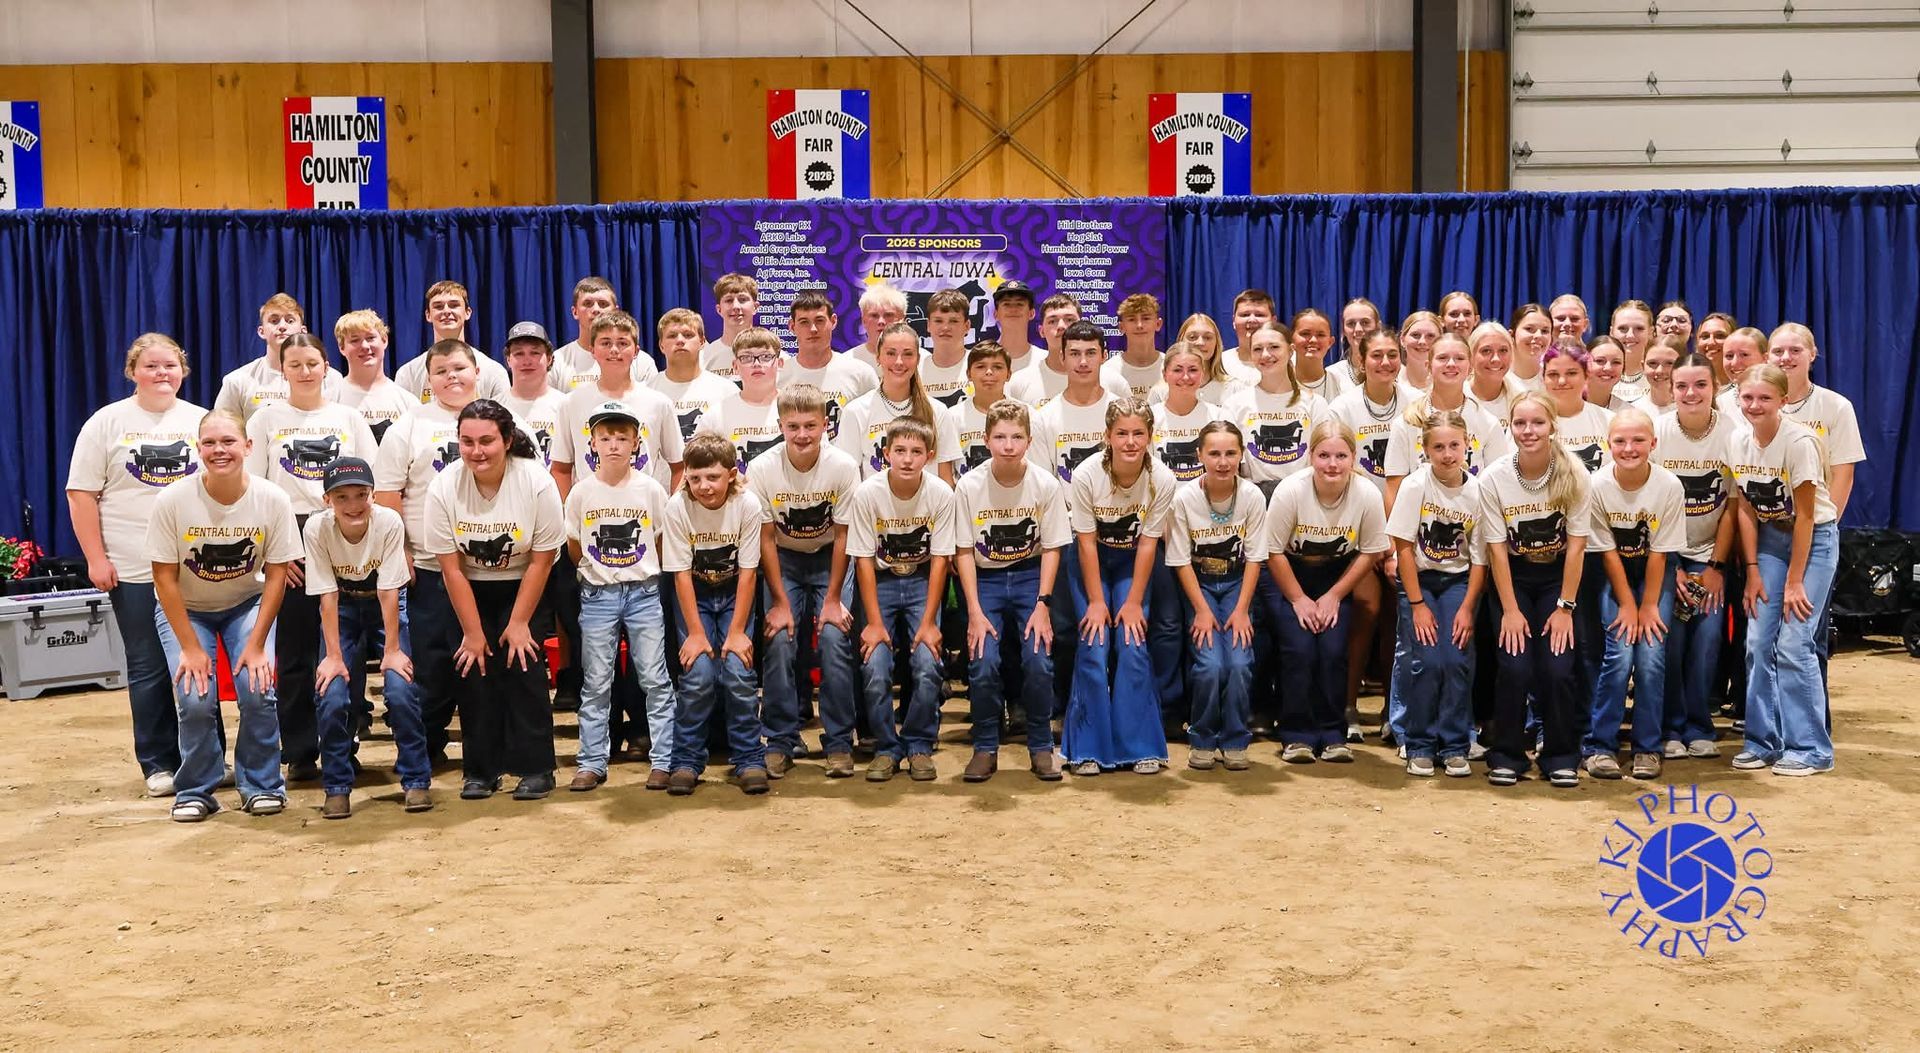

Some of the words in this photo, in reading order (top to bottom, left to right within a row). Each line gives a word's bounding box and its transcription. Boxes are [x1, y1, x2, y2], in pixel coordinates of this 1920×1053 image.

[291, 114, 378, 141] HAMILTON
[772, 109, 822, 138] HAMILTON
[825, 110, 865, 138] COUNTY
[1153, 112, 1203, 141] HAMILTON
[1206, 113, 1246, 141] COUNTY
[0, 121, 36, 150] OUNTY
[804, 138, 833, 152] FAIR
[1185, 142, 1213, 155] FAIR
[302, 156, 370, 183] COUNTY
[754, 220, 798, 232] Agronomy
[798, 220, 812, 230] RX
[1076, 220, 1112, 230] Brothers
[760, 232, 785, 242] ARKO
[785, 232, 806, 242] Labs
[1067, 232, 1085, 243] Hog
[1086, 232, 1103, 241] Slat
[886, 238, 916, 248] 2026
[918, 239, 982, 249] SPONSORS
[1041, 244, 1083, 253] Humboldt
[1084, 244, 1102, 253] Red
[1102, 244, 1129, 253] Power
[740, 244, 768, 253] Arnold
[769, 244, 790, 255] Crop
[790, 244, 826, 253] Services
[765, 256, 778, 265] Bio
[779, 256, 814, 265] America
[1058, 255, 1112, 267] Huvepharma
[872, 262, 944, 278] CENTRAL
[949, 262, 996, 278] IOWA
[1063, 268, 1085, 277] Iowa
[1085, 268, 1106, 277] Corn
[1055, 280, 1076, 289] Koch
[1077, 280, 1114, 289] Fertilizer
[757, 292, 773, 301] tler
[774, 292, 800, 301] Count
[774, 304, 791, 313] Far
[1081, 303, 1099, 313] erck
[572, 375, 600, 383] CENTRA
[279, 427, 317, 436] CENTRAL
[734, 427, 769, 436] CENTRAL
[869, 423, 890, 433] CENT
[1058, 432, 1091, 443] CENTRAL
[1259, 450, 1298, 462] Showdown
[1663, 460, 1700, 469] CENTRAL
[1734, 464, 1767, 475] CENTRAL
[294, 466, 324, 478] Showdo
[776, 493, 810, 503] CENTRAL
[812, 490, 835, 501] IOWA
[586, 508, 621, 520] CENTRAL
[623, 509, 648, 519] IOWA
[978, 509, 1014, 520] CENTRAL
[1016, 508, 1035, 517] IOW
[1095, 507, 1125, 516] ENTRAL
[1504, 503, 1542, 516] CENTRAL
[1685, 503, 1715, 514] wdown
[1606, 512, 1632, 522] NTRAL
[187, 526, 230, 537] CENTRAL
[233, 527, 261, 537] IOWA
[458, 521, 492, 533] CENTRAL
[493, 522, 518, 532] IOWA
[1330, 525, 1353, 535] IOWA
[720, 533, 737, 543] IOW
[1191, 528, 1221, 538] ENTRAL
[990, 548, 1031, 560] Showdown
[332, 565, 361, 575] NTRAL
[47, 634, 88, 647] Grizzly
